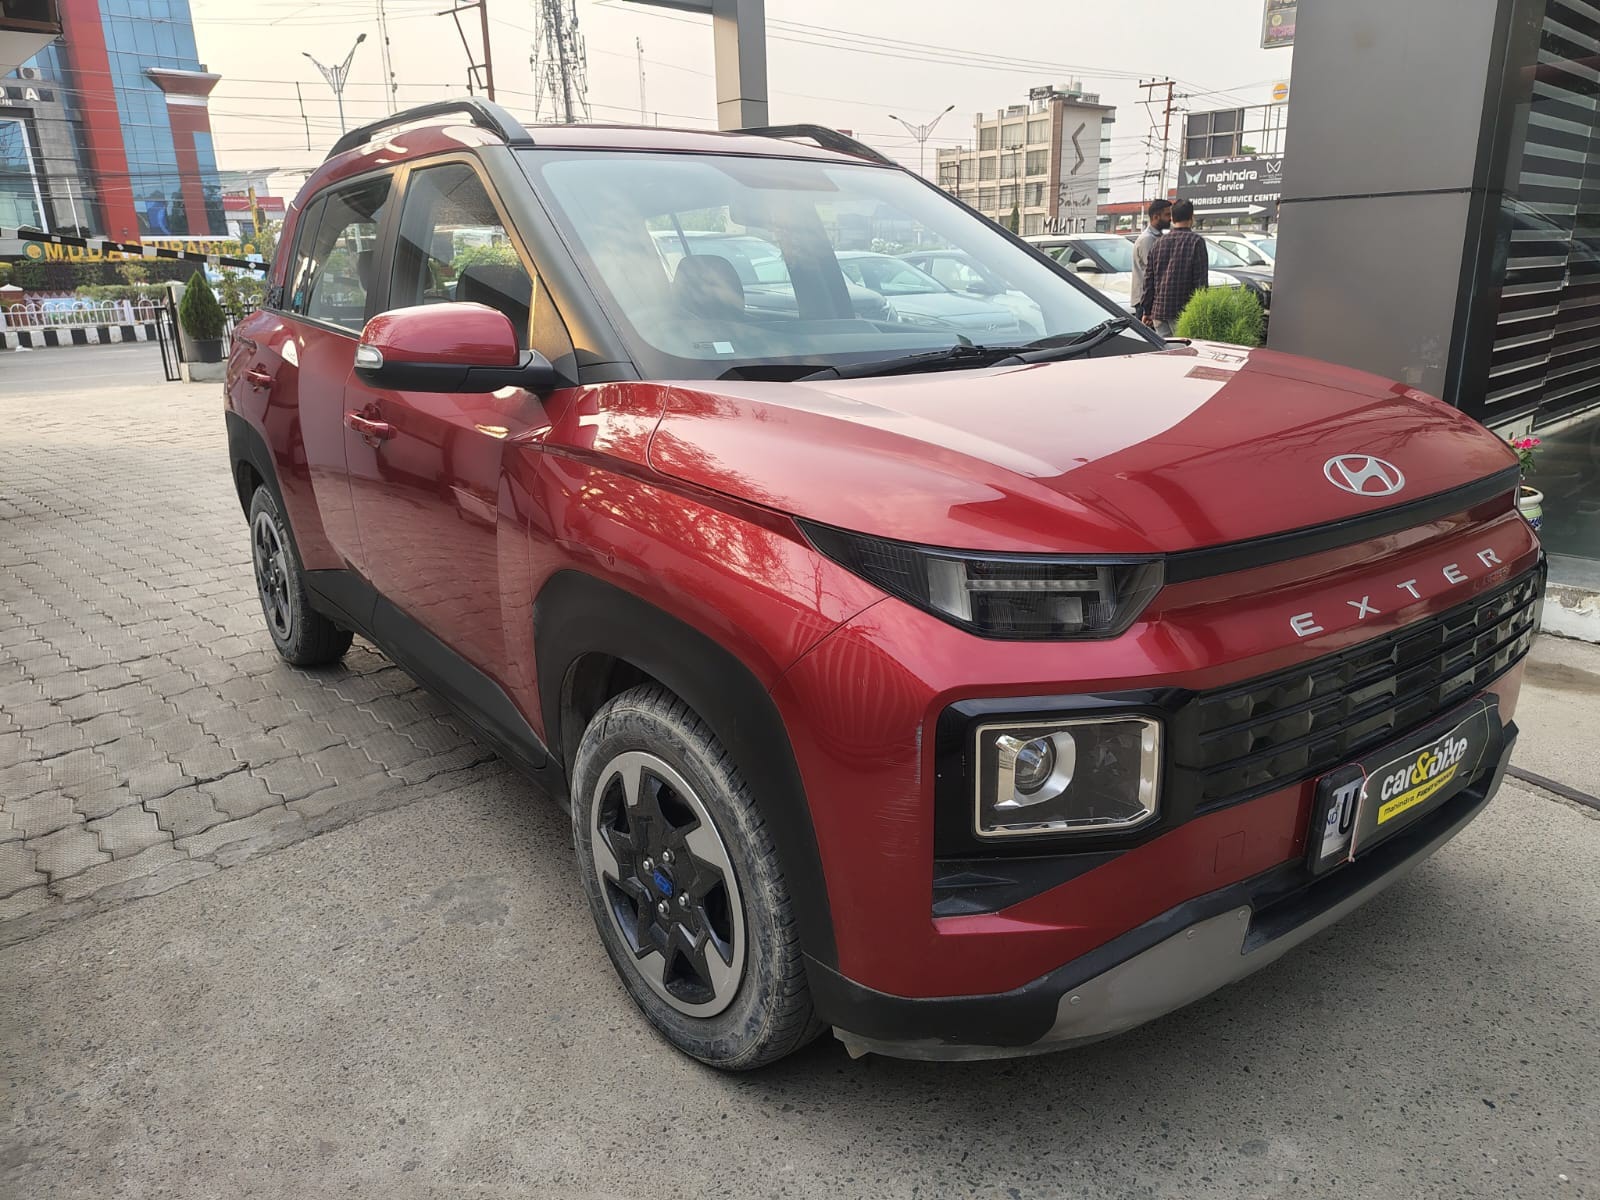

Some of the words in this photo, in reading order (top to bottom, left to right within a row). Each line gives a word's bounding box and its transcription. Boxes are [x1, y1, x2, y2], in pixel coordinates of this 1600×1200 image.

[1206, 168, 1258, 184] mahindra
[1216, 181, 1245, 192] Service
[1223, 194, 1252, 204] SERVICE
[1290, 547, 1503, 637] EXTER
[1380, 736, 1468, 801] car&bike
